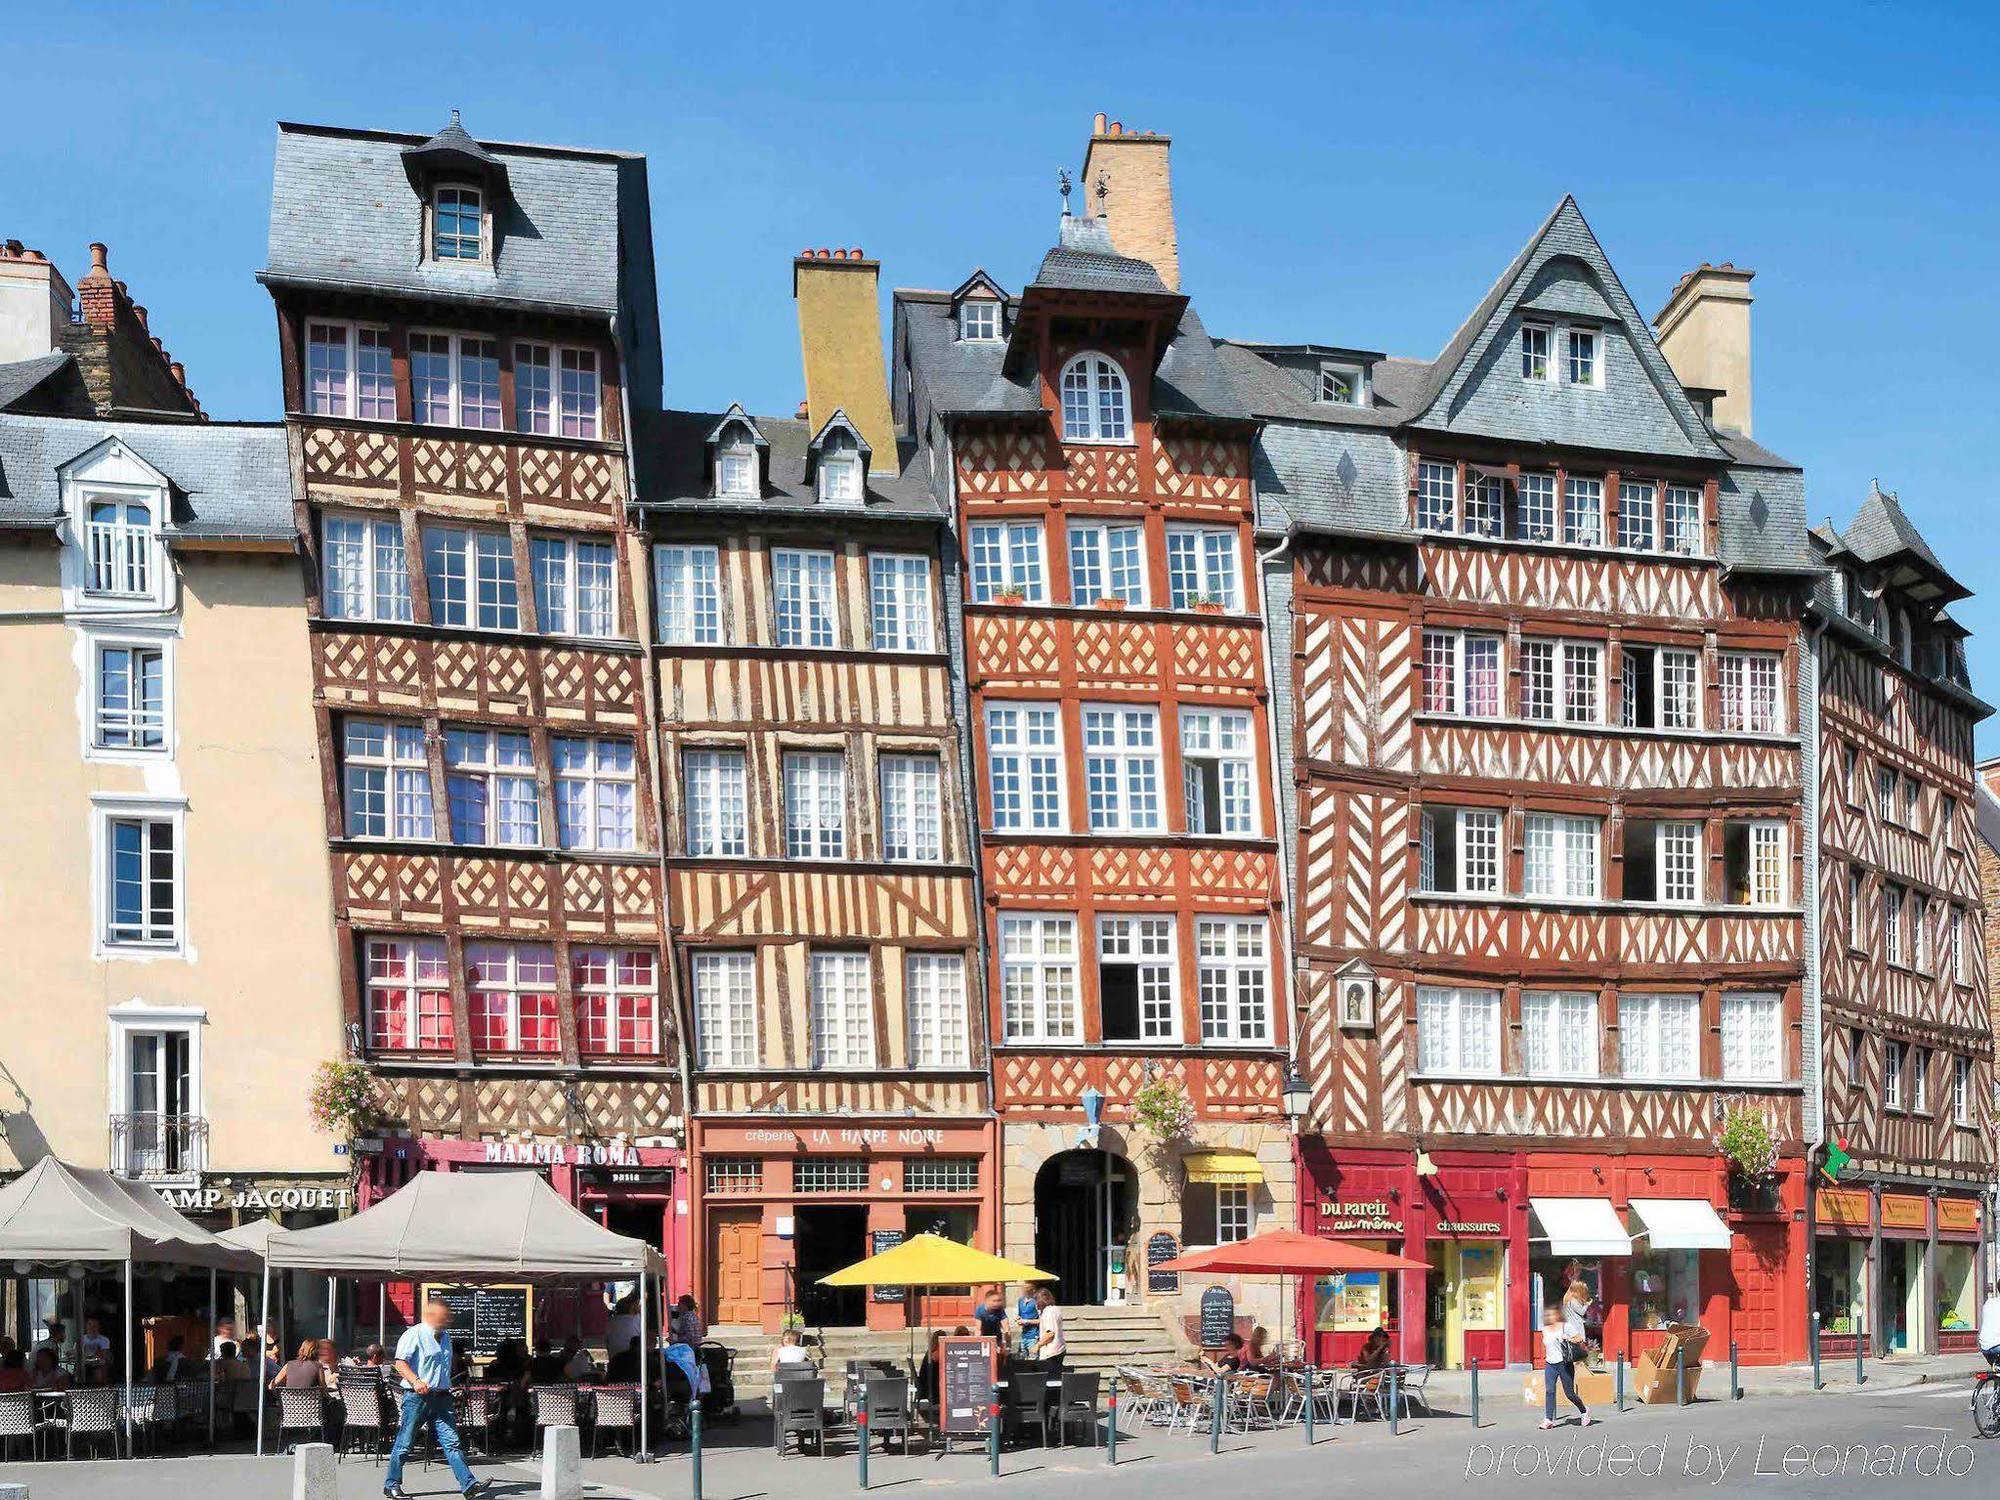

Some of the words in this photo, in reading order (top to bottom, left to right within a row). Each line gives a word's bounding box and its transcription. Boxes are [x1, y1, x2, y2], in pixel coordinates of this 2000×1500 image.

[745, 1128, 796, 1144] crêperie
[812, 1129, 831, 1144] LA
[841, 1129, 888, 1144] HARPE
[898, 1129, 944, 1144] NOIRE
[486, 1143, 565, 1164] MAMMA
[577, 1145, 640, 1166] ROMA
[232, 1189, 350, 1208] JACQUET
[1437, 1221, 1501, 1232] chaussures
